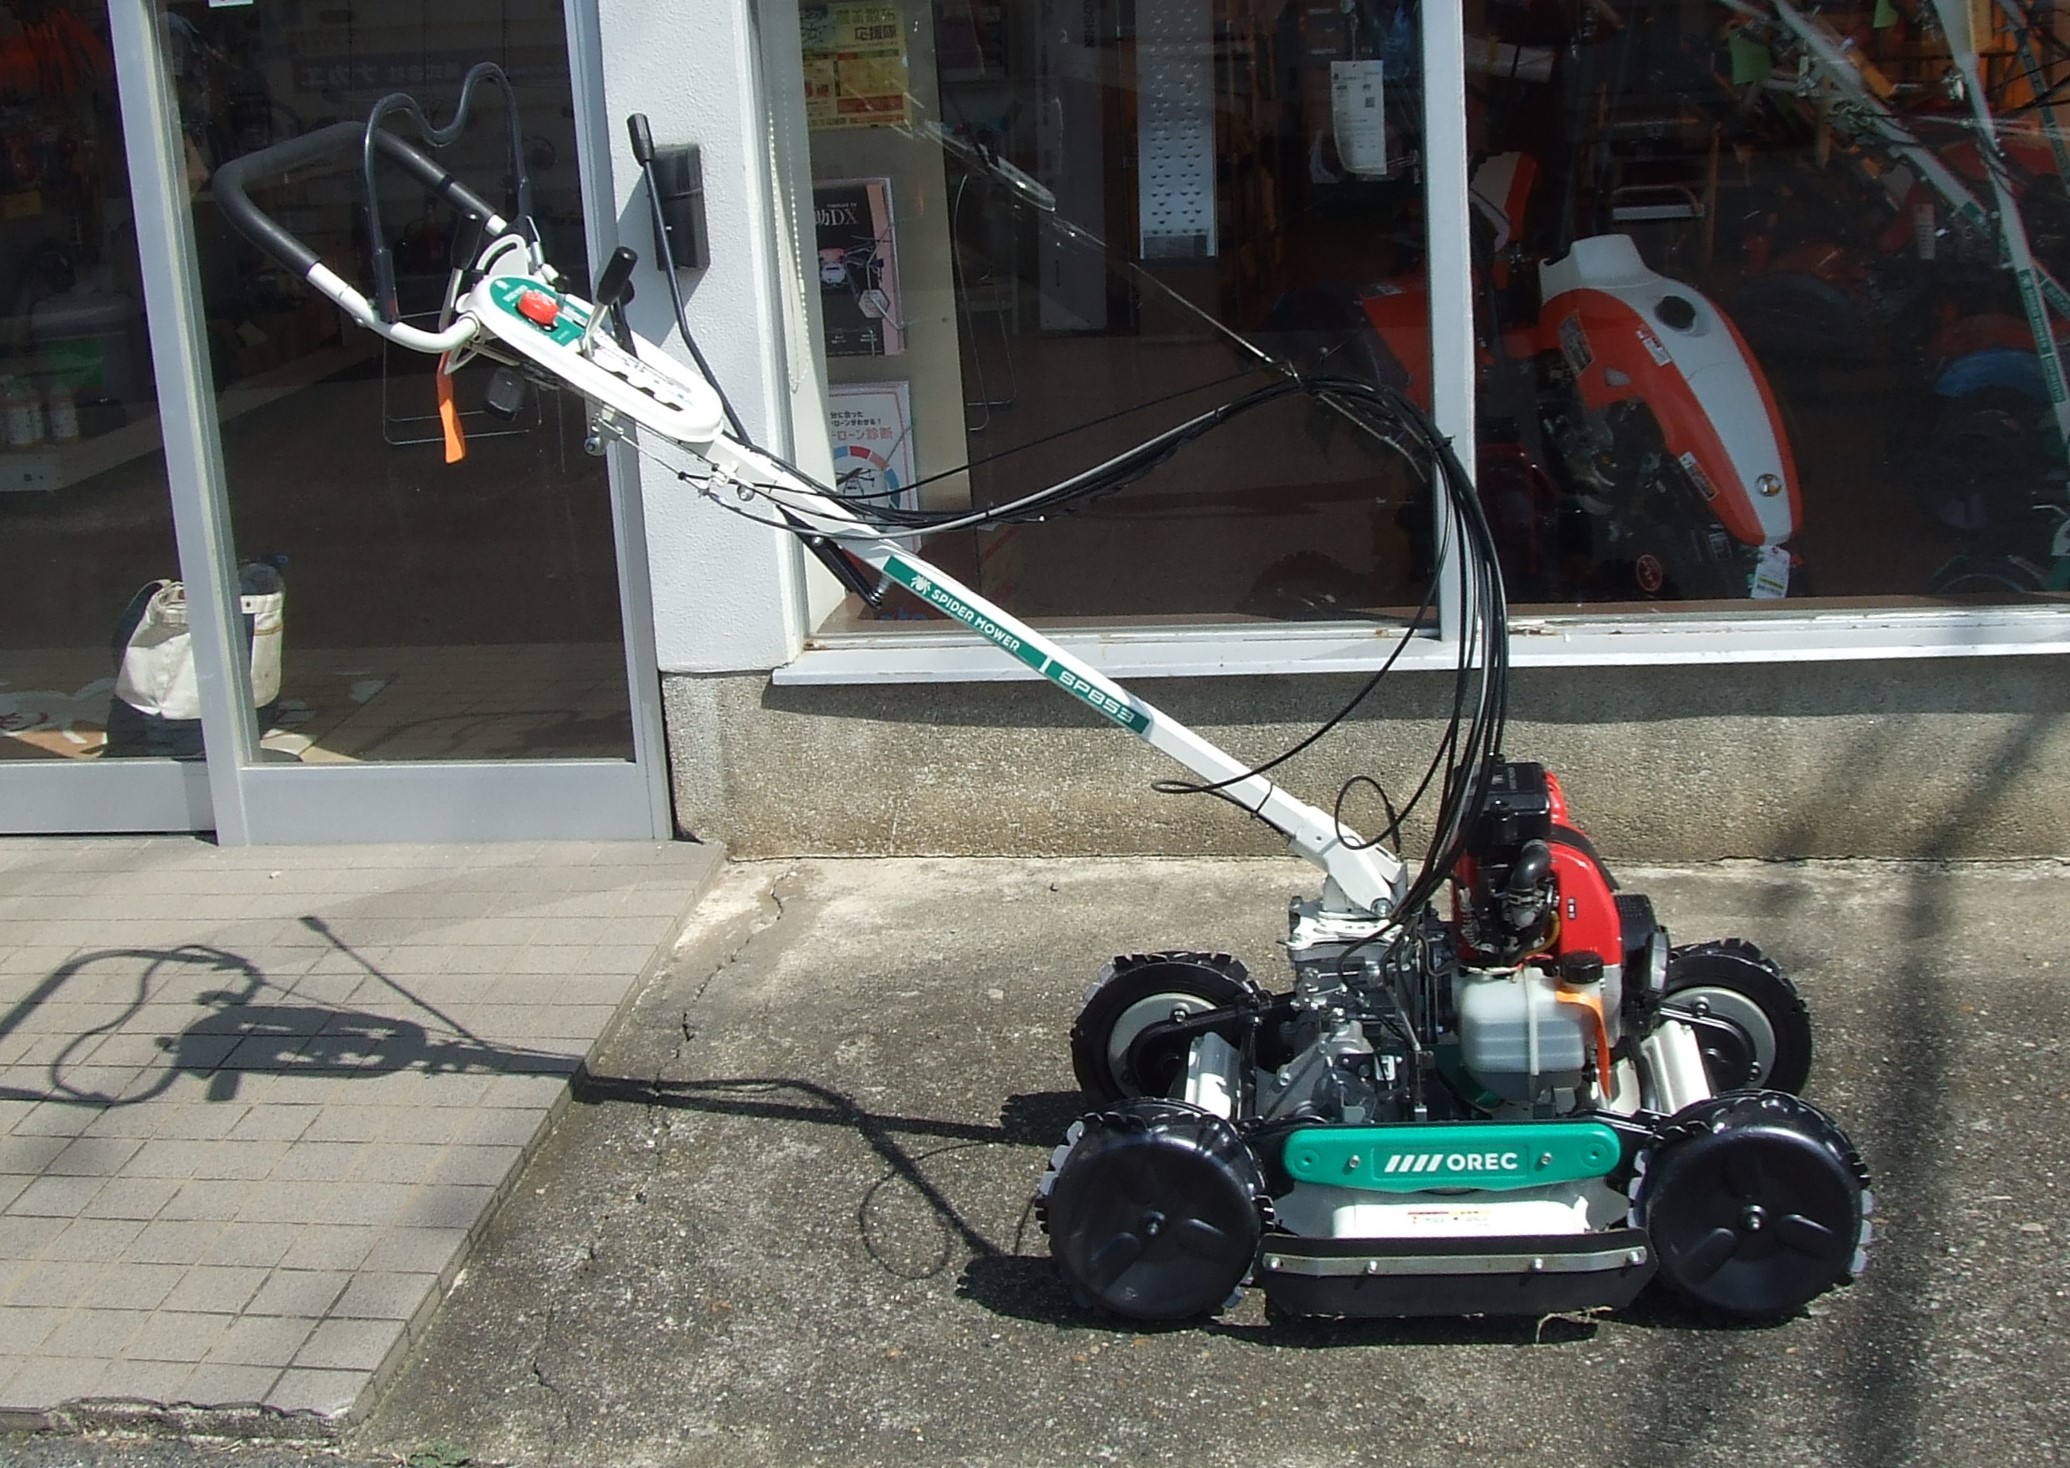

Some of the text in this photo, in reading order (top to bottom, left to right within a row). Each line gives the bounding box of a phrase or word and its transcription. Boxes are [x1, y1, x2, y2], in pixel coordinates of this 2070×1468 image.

[855, 25, 896, 40] 応援隊
[931, 589, 1020, 652] SPIDER MOWER
[1059, 671, 1135, 723] SP853
[1446, 1152, 1518, 1171] OREC
